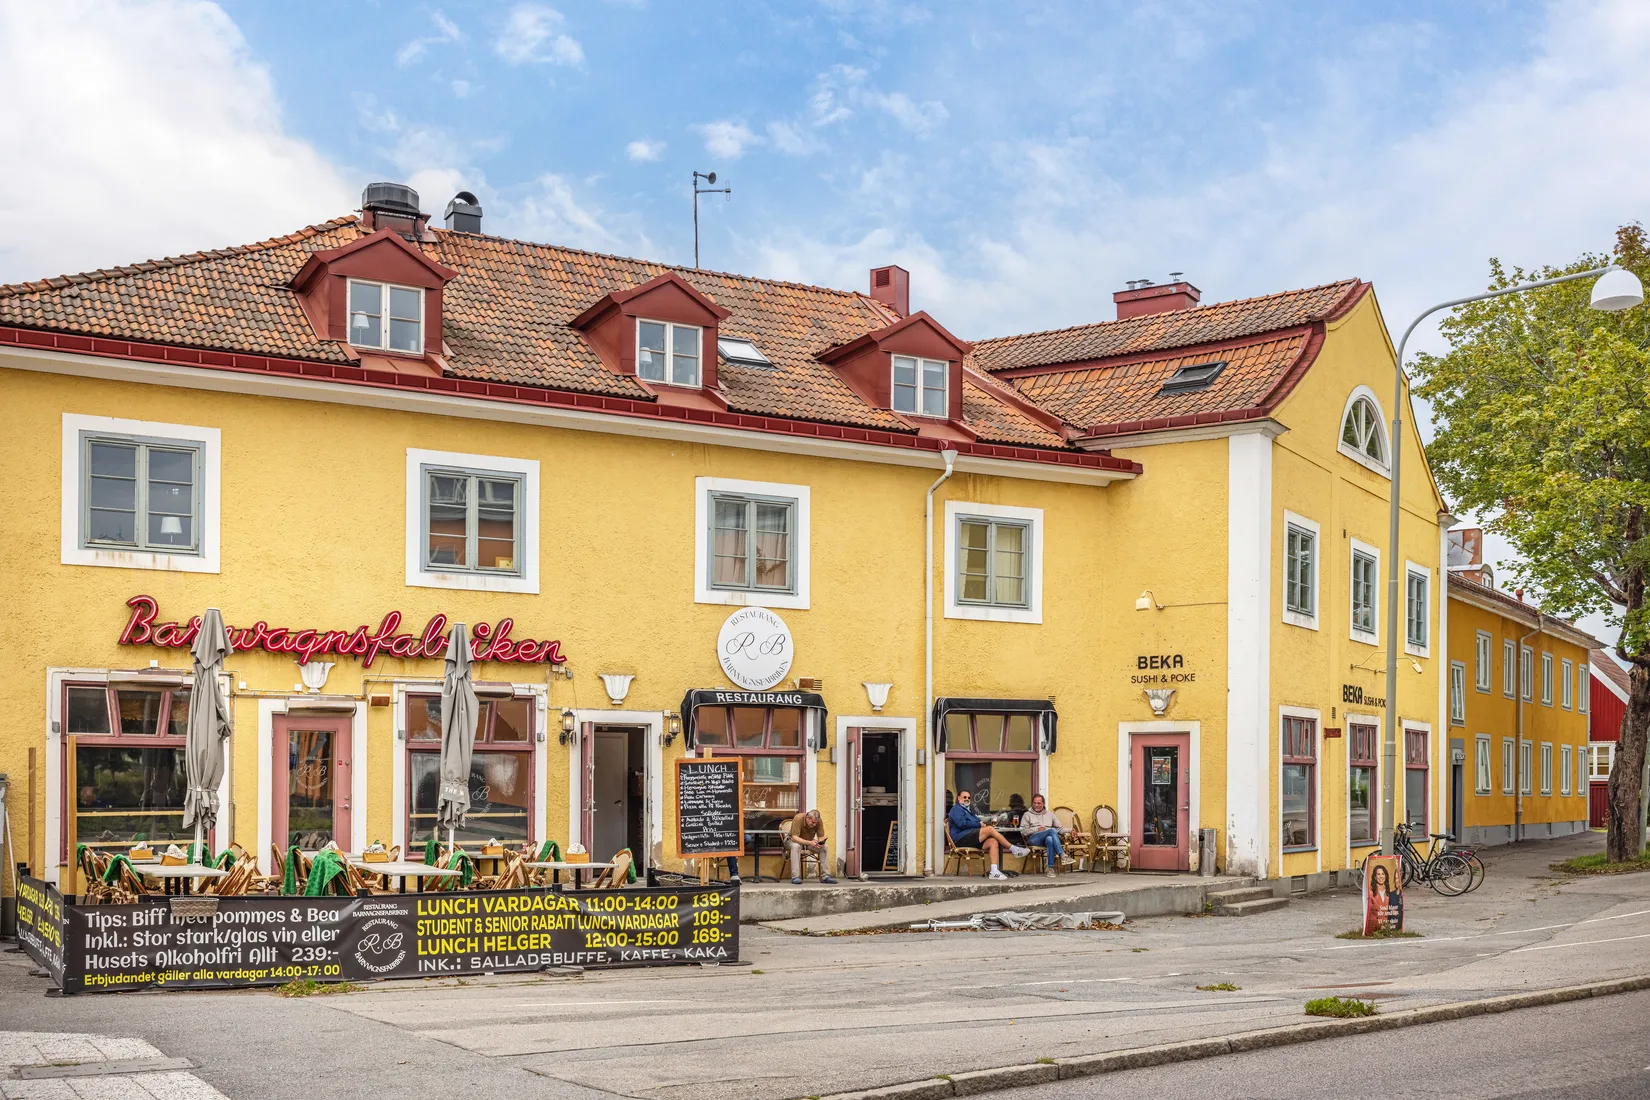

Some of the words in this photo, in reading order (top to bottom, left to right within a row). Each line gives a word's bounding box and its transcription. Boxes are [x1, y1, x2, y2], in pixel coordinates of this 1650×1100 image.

[730, 610, 780, 629] RESTAURANG
[1137, 654, 1184, 670] BEKA
[1131, 675, 1158, 684] SUSHI
[1160, 674, 1168, 683] &
[1170, 673, 1196, 682] POKE
[716, 692, 803, 705] RESTAURANG
[1343, 684, 1363, 704] BEKA
[688, 764, 727, 774] LUNCH
[445, 786, 458, 795] THE
[352, 909, 409, 918] BARNVAGNSFABRIKEN
[363, 903, 398, 911] RESTAURANG
[417, 897, 479, 916] LUNCH
[482, 894, 581, 913] VARDAGAR
[585, 895, 679, 912] 11:00-14:00
[692, 892, 731, 908] 139:-
[85, 911, 127, 932] Tips:
[132, 907, 167, 926] Biff
[212, 910, 286, 929] pommes
[290, 908, 302, 922] &
[307, 908, 340, 922] Bea
[361, 917, 399, 932] RESTAURANG
[416, 917, 473, 937] STUDENT
[474, 917, 483, 934] &
[485, 915, 529, 933] SENIOR
[531, 914, 576, 931] RABATT
[578, 914, 617, 931] LUNCH
[617, 912, 680, 930] VARDAGAR
[693, 909, 731, 926] 109:-
[85, 931, 128, 950] Inkl.:
[133, 930, 172, 947] Stor
[176, 926, 268, 948] stark/glas
[272, 926, 297, 944] vin
[301, 925, 340, 942] eller
[417, 937, 479, 956] LUNCH
[484, 933, 552, 953] HELGER
[585, 930, 679, 948] 12:00-15:00
[691, 927, 732, 944] 169:-
[85, 951, 148, 970] Husets
[155, 946, 242, 968] Alkoholfri
[249, 945, 279, 965] Allt
[291, 946, 339, 962] 239:-
[354, 949, 407, 973] BARNVAGNSFABRIKEN
[418, 957, 462, 972] INK.:
[470, 951, 612, 969] SALLADSBUFFE,
[620, 948, 677, 961] KAFFE,
[684, 945, 728, 958] KAKA
[84, 971, 156, 987] Erbjudandet
[158, 969, 191, 985] gäller
[193, 968, 214, 979] alla
[216, 967, 269, 981] vardagar
[270, 965, 322, 977] 14:00-17:
